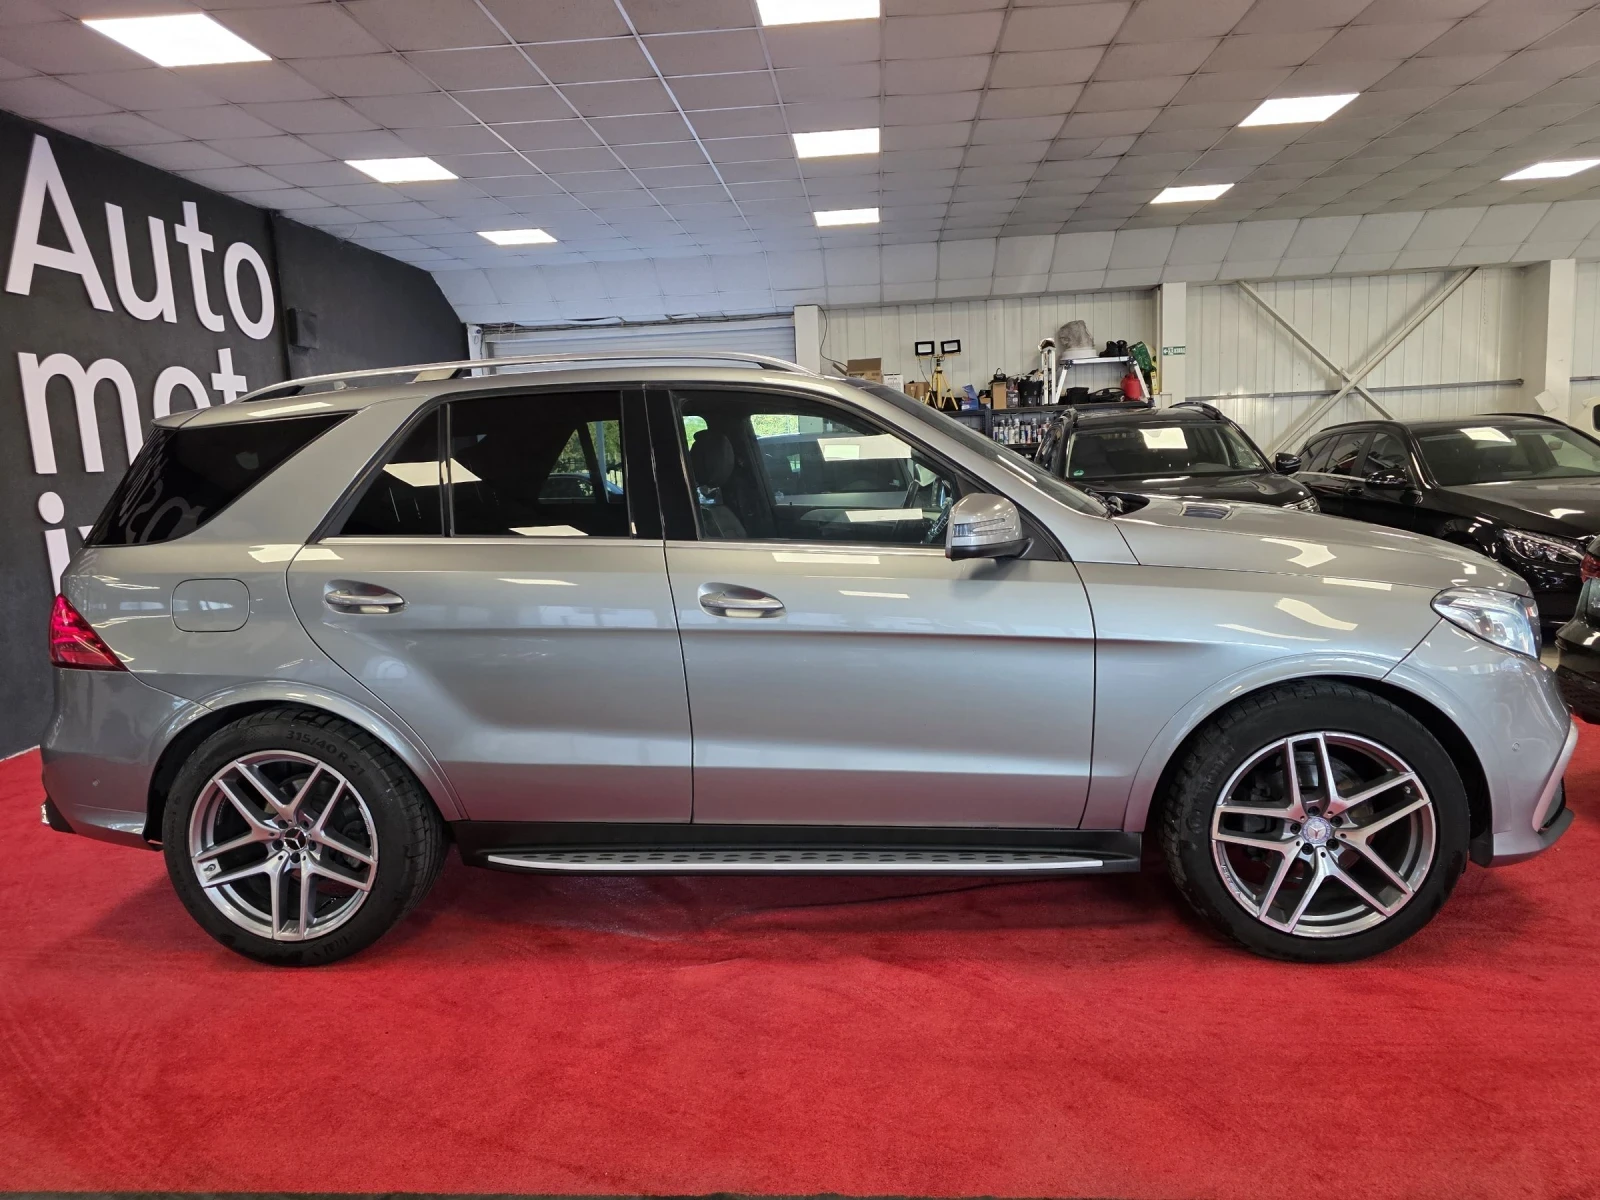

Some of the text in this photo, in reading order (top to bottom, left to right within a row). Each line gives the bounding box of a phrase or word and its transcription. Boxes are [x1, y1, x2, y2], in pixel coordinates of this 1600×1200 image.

[5, 134, 275, 340] Auto
[287, 731, 365, 775] 315/40 R 21
